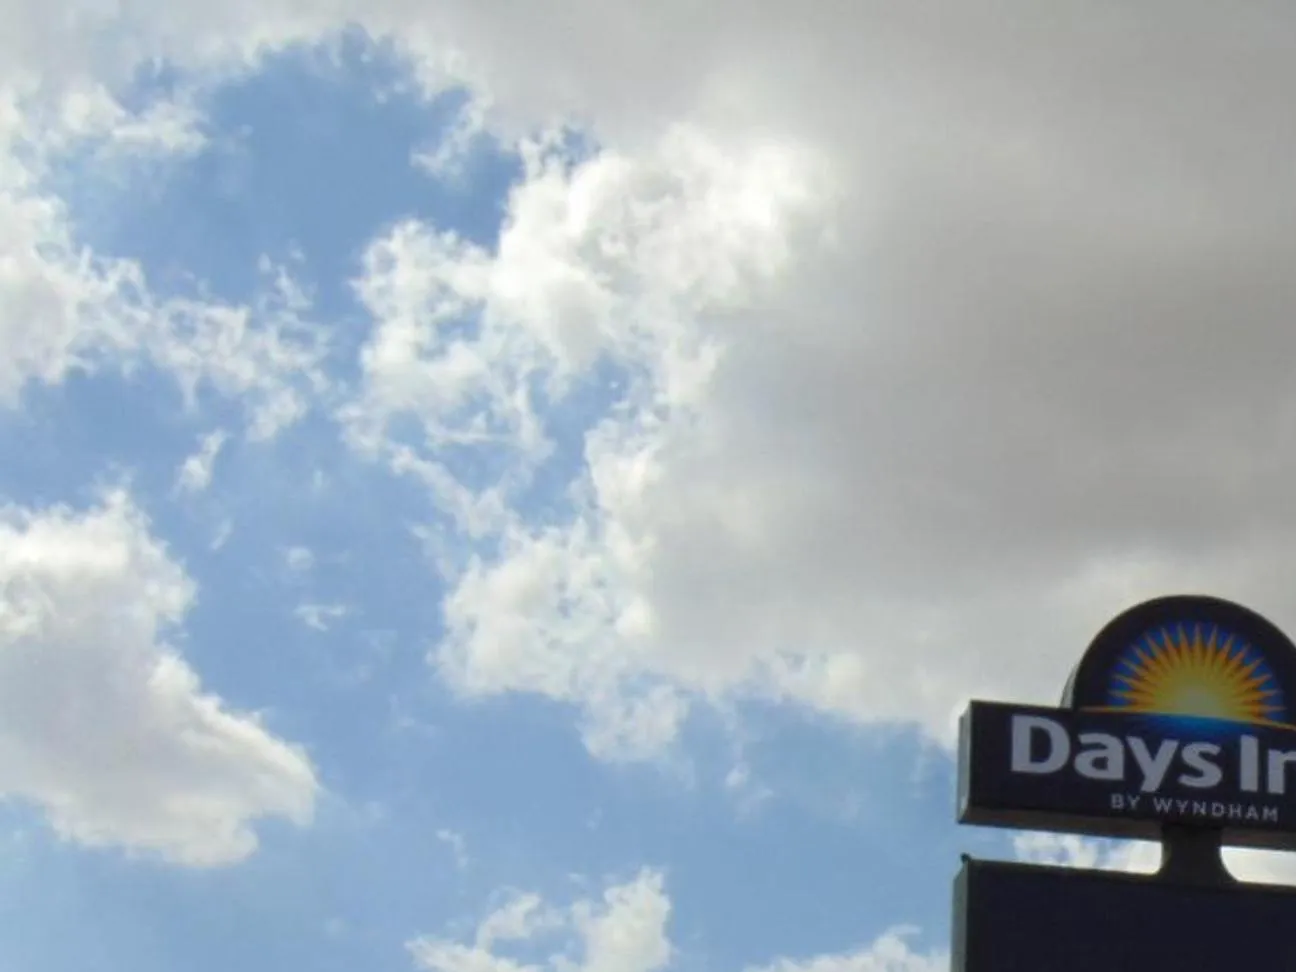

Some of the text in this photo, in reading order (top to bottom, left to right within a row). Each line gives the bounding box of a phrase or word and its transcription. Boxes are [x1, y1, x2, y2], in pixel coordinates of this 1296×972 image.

[1010, 713, 1224, 793] Days
[1110, 793, 1279, 823] BY WYNDHAM
